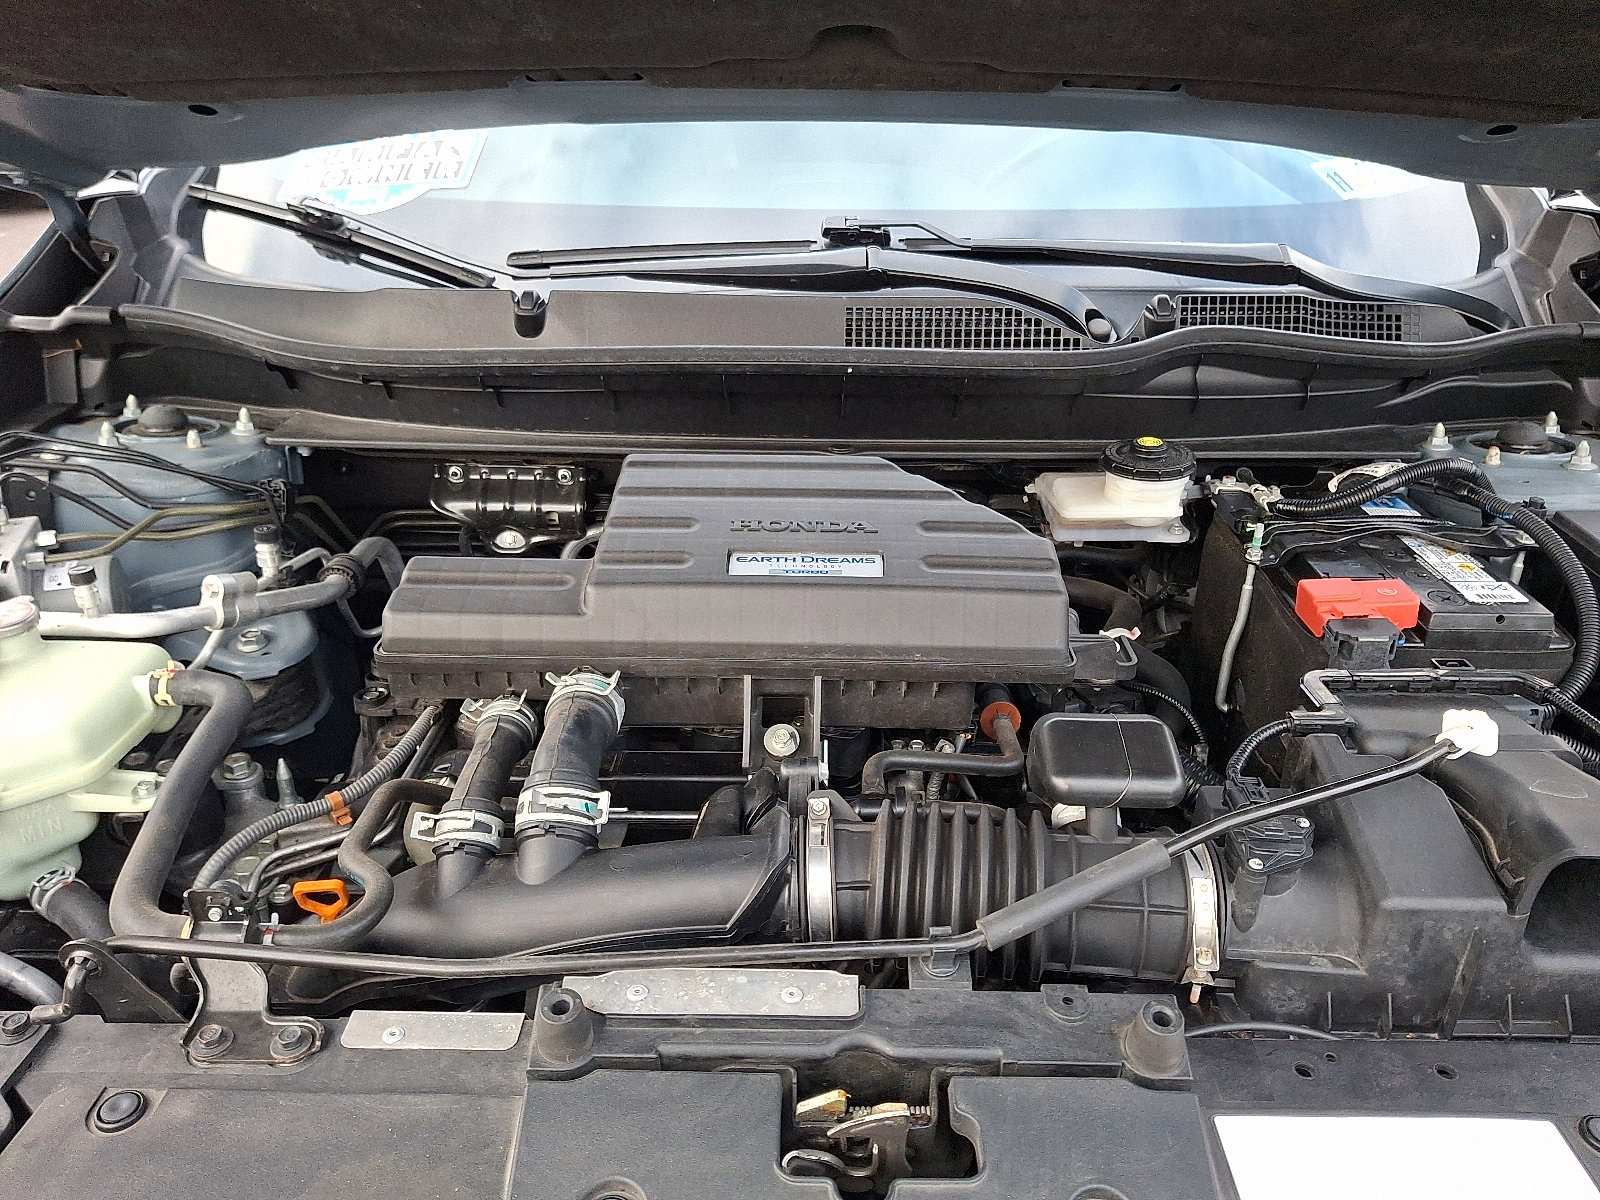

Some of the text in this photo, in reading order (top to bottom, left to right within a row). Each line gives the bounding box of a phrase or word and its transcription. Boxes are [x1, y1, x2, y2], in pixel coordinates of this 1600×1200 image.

[730, 519, 878, 533] HONDA
[735, 555, 876, 565] EARTH DREAMS
